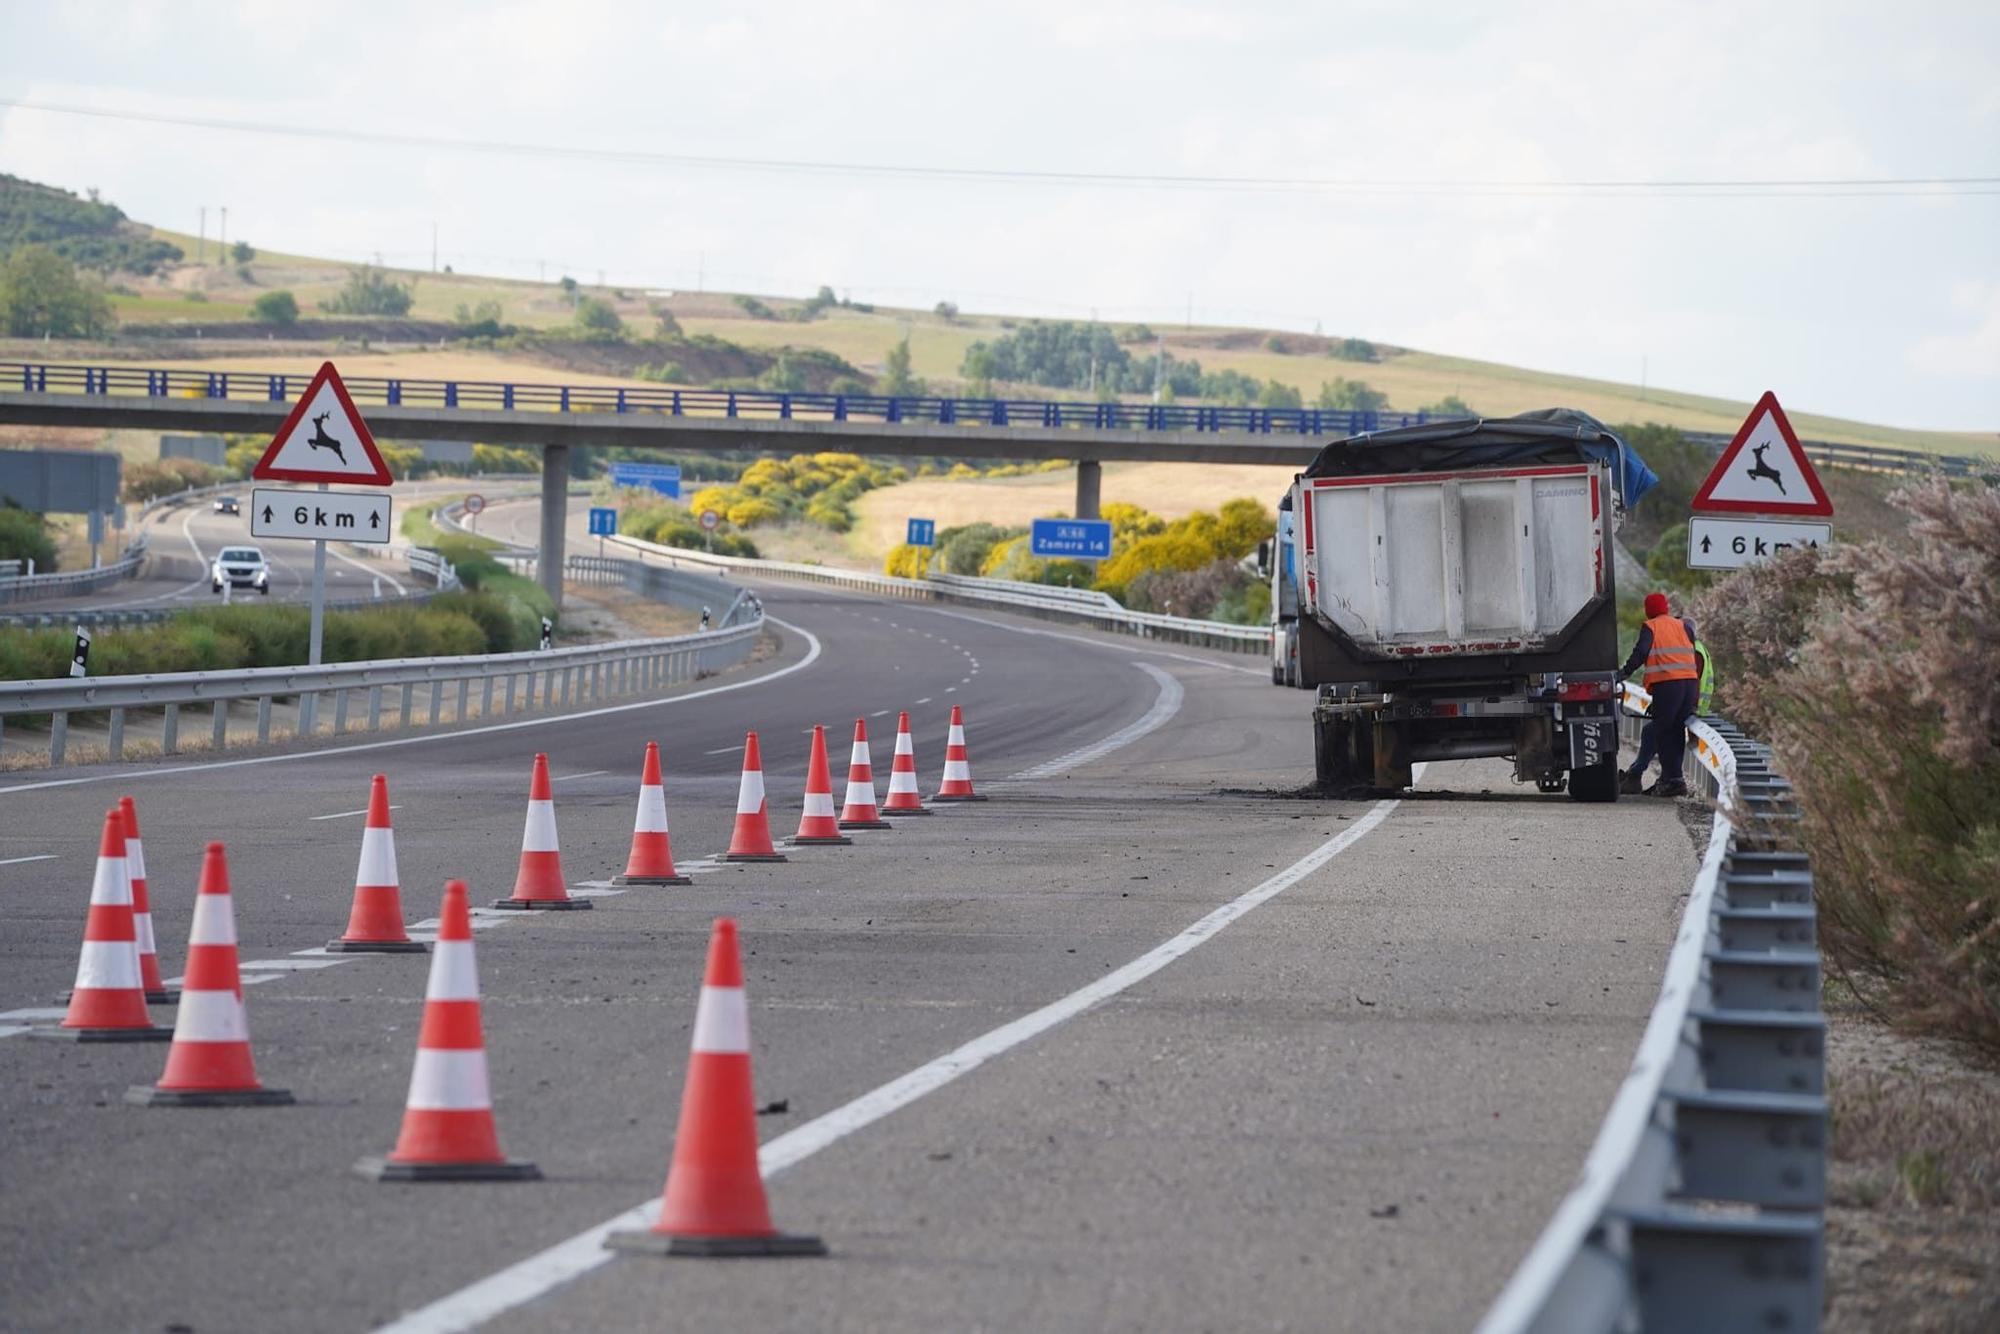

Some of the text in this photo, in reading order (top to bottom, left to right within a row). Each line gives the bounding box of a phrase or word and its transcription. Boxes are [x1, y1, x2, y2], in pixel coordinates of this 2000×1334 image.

[294, 506, 355, 528] 6 km
[1732, 536, 1746, 554] 6
